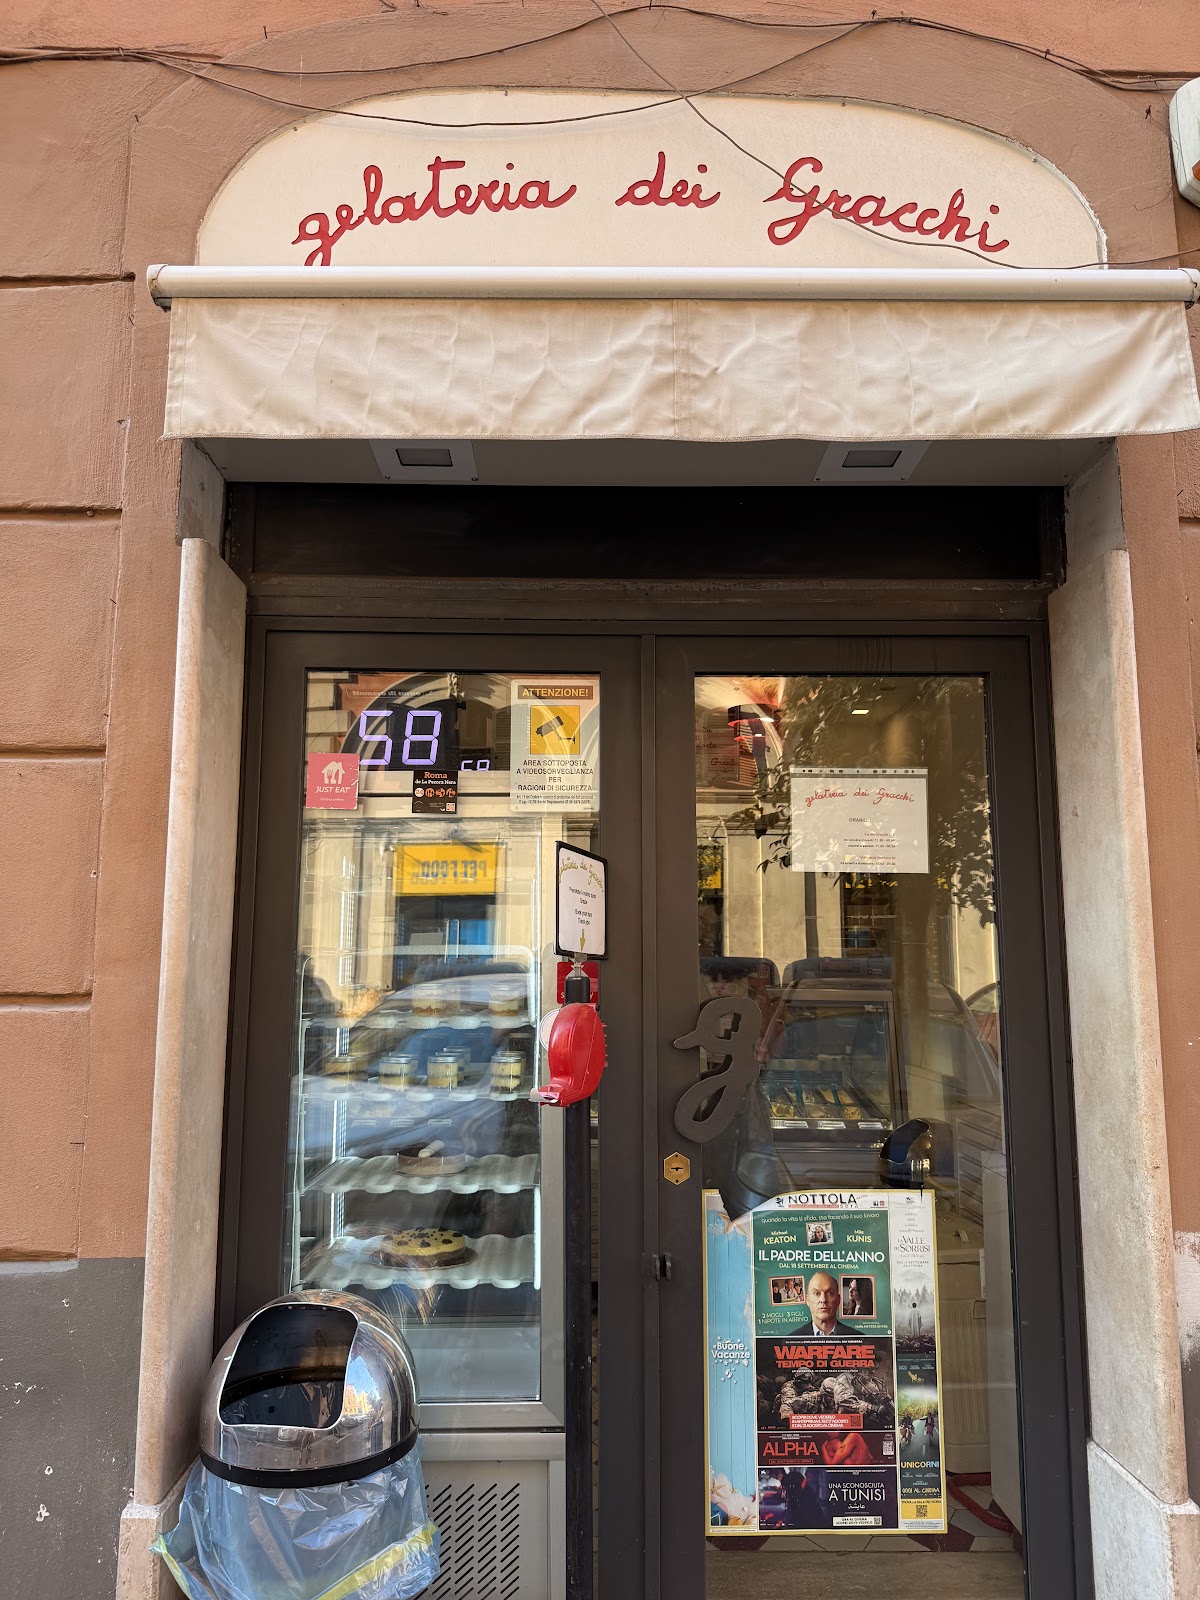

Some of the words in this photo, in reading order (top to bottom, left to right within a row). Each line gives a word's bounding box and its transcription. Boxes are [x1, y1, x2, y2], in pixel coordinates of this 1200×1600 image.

[292, 154, 577, 266] gelateria
[615, 151, 721, 207] dei
[763, 157, 1009, 254] Gracchi
[522, 688, 589, 697] ATTENZIONE!
[359, 710, 442, 765] 58
[423, 771, 448, 779] Roma
[315, 786, 334, 794] JUST
[335, 786, 351, 794] EAT
[805, 789, 848, 808] gelateria
[853, 787, 870, 798] dei
[873, 787, 914, 805] Gracchi
[788, 1193, 857, 1205] NOTTOLA
[763, 1235, 797, 1245] KEATON
[846, 1234, 872, 1243] KUNIS
[902, 1235, 926, 1245] VALLE
[900, 1244, 931, 1252] SORRISI
[758, 1250, 772, 1261] IL
[773, 1250, 812, 1262] PADRE
[813, 1250, 885, 1263] DELL'ANNO
[717, 1341, 745, 1350] Buone
[711, 1349, 751, 1359] Vacanze
[774, 1345, 875, 1360] WARFARE
[776, 1360, 814, 1369] TEMPO
[816, 1360, 828, 1368] DI
[829, 1359, 875, 1368] GUERRA
[763, 1441, 819, 1456] ALPHA
[900, 1461, 940, 1469] UNICORNI
[829, 1489, 839, 1502] A
[842, 1488, 886, 1501] TUNISI
